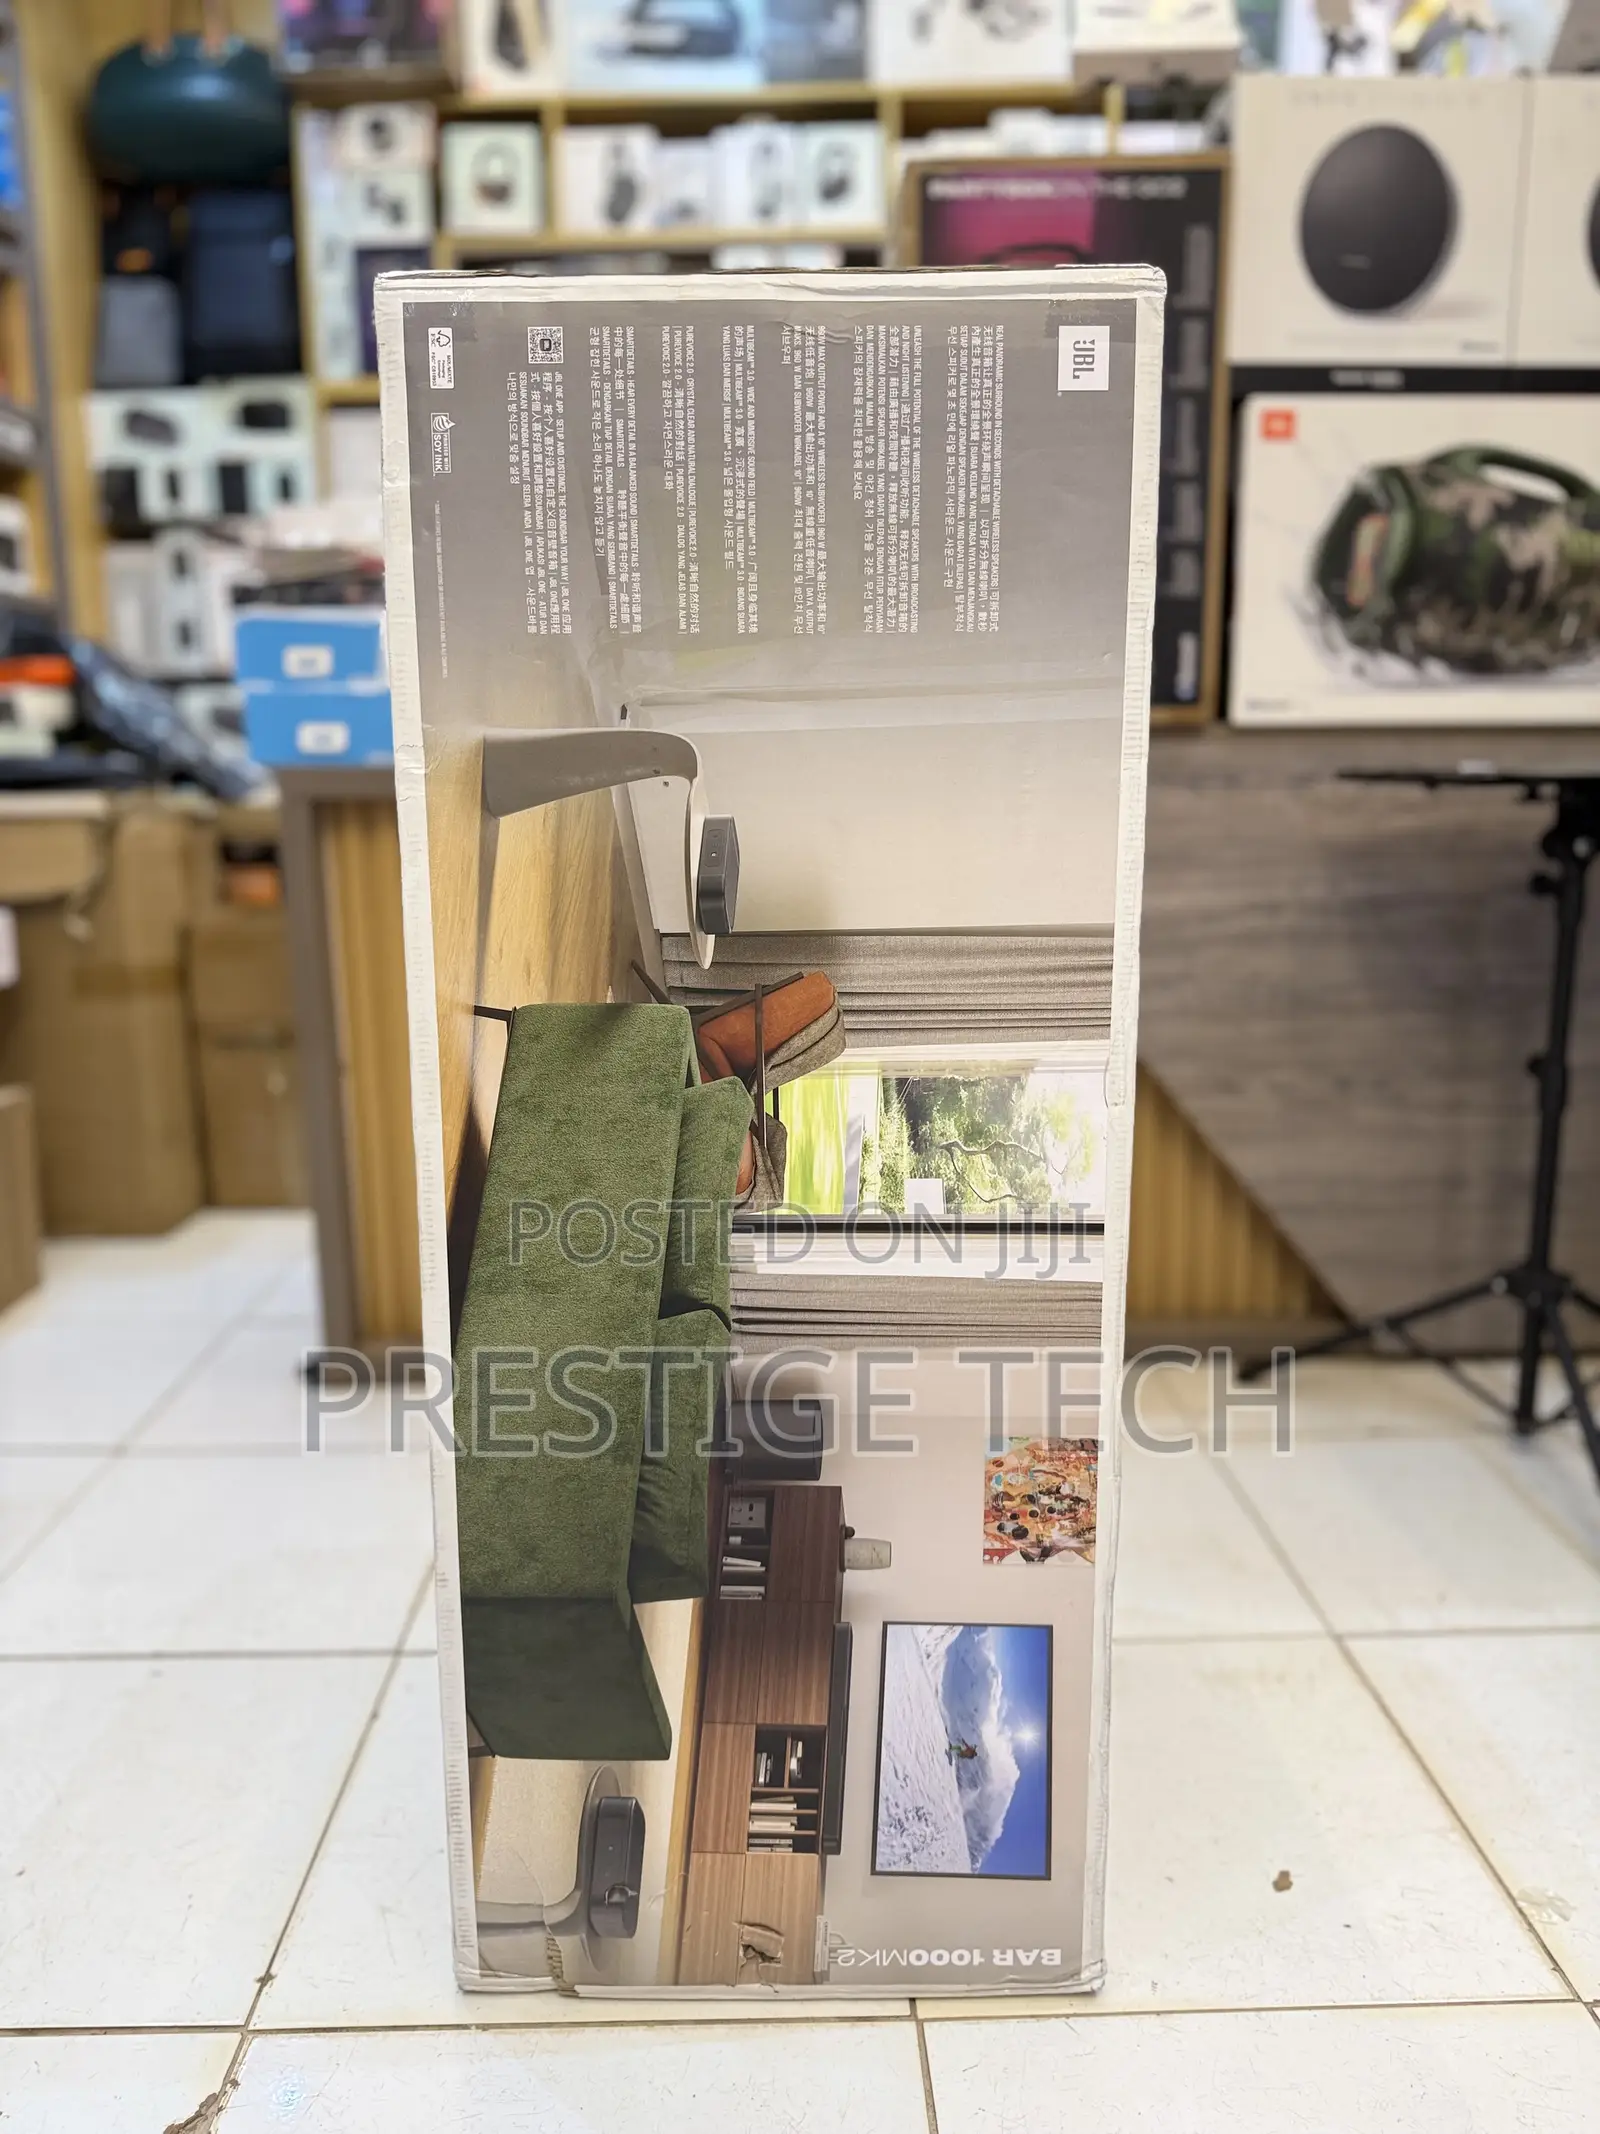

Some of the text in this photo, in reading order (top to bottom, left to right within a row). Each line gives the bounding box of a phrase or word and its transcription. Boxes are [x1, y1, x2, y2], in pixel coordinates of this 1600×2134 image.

[590, 327, 600, 346] 균형
[662, 326, 670, 362] PUREVOICE
[686, 326, 694, 362] PUREVOICE
[782, 326, 791, 364] 서브우퍼
[854, 325, 863, 364] 스피커의
[914, 325, 922, 355] UNLEASH
[948, 326, 957, 344] 무선
[960, 325, 968, 347] SETIAP
[996, 325, 1004, 341] REAL
[626, 326, 635, 375] SMARTDETAILS
[878, 325, 886, 375] MAKSIMALKAN
[902, 341, 910, 362] NIGHT
[960, 349, 968, 372] SUDUT
[995, 342, 1004, 382] PANORAMIC
[1073, 339, 1095, 380] JBL
[662, 363, 670, 374] 2.0
[686, 362, 694, 373] 2.0
[902, 363, 910, 397] LISTENING
[948, 347, 958, 386] 스피커로
[591, 370, 601, 409] 사운드로
[627, 380, 635, 398] HEAR
[686, 378, 695, 407] CRYSTAL
[878, 377, 886, 405] POTENSI
[959, 373, 968, 396] DALAM
[627, 399, 636, 419] EVERY
[913, 389, 921, 424] POTENTIAL
[948, 400, 957, 410] 초
[959, 397, 967, 426] SEKEJAP
[994, 383, 1003, 420] SURROUND
[507, 372, 520, 484] 나만의 방식으로 맞춤 설정
[592, 411, 601, 430] 작은
[628, 420, 636, 442] DETAIL
[687, 408, 695, 429] CLEAR
[853, 408, 863, 437] 최대한
[878, 406, 886, 437] SPEAKER
[913, 426, 921, 435] OF
[947, 412, 956, 432] 만에
[434, 434, 442, 452] SOY
[593, 432, 602, 452] 소리
[663, 420, 673, 468] 자연스러운
[687, 430, 695, 444] AND
[747, 420, 755, 455] IMMERSIVE
[946, 434, 956, 453] 리얼
[959, 428, 967, 455] DENGAN
[994, 429, 1002, 459] SECONDS
[593, 454, 603, 483] 하나도
[688, 444, 696, 474] NATURAL
[747, 456, 755, 478] SOUND
[877, 439, 885, 471] NIRKABEL
[912, 451, 921, 483] WIRELESS
[993, 460, 1002, 478] WITH
[629, 457, 637, 491] BALANCED
[664, 471, 674, 490] 대화
[854, 471, 863, 500] 보세요
[946, 456, 956, 494] 파노라믹
[958, 457, 966, 486] SPEAKER
[554, 372, 572, 634] JBL ONE APP SETUP AND CUSTOMIZE THE SOUNDBAR YOUR WAY JBL ONE 应用
[629, 492, 638, 515] SOUND
[688, 475, 696, 506] DIALOGUE
[877, 494, 885, 516] DAPAT
[957, 487, 966, 519] NIRKABEL
[992, 479, 1001, 520] DETACHABLE
[912, 485, 920, 526] DETACHABLE
[945, 497, 955, 536] 서라운드
[594, 516, 604, 535] 않고
[688, 511, 697, 546] PUREVOICE
[957, 520, 965, 539] YANG
[992, 521, 1000, 553] WIRELESS
[630, 519, 639, 567] SMARTDETAILS
[911, 528, 919, 562] SPEAKERS
[944, 538, 954, 566] 사운드
[957, 540, 965, 562] DAPAT
[911, 564, 919, 581] WITH
[944, 568, 953, 588] 구현
[956, 563, 964, 589] DILEPAS
[991, 554, 999, 587] SPEAKERS
[876, 596, 884, 633] PENYIARAN
[910, 583, 918, 633] BROADCASTING
[989, 591, 999, 632] 可拆卸式
[837, 1948, 1062, 1967] BAR 1000MK2
